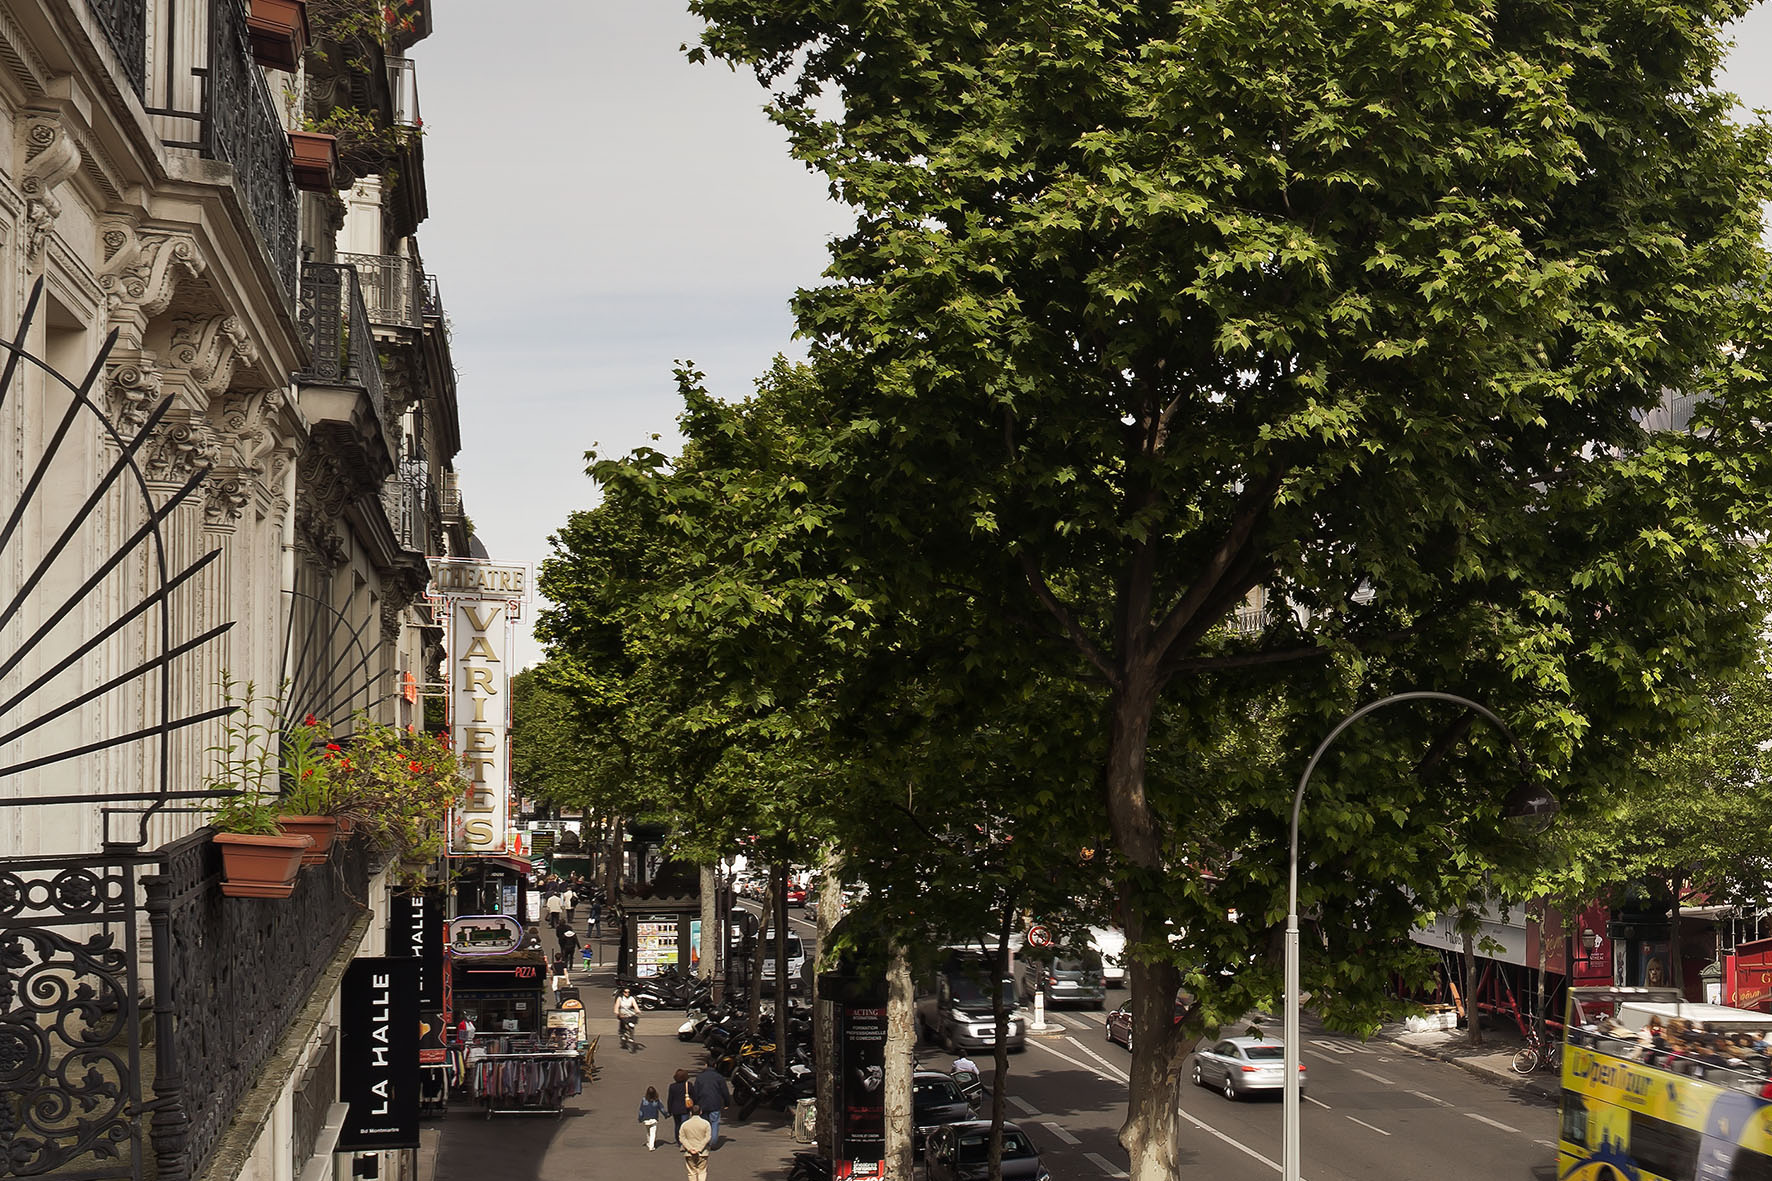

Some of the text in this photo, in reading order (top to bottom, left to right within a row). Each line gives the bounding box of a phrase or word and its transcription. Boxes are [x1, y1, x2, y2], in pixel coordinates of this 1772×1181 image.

[459, 605, 502, 846] VARIETES
[515, 966, 536, 978] PIZZA
[371, 973, 390, 1115] LA HALLE
